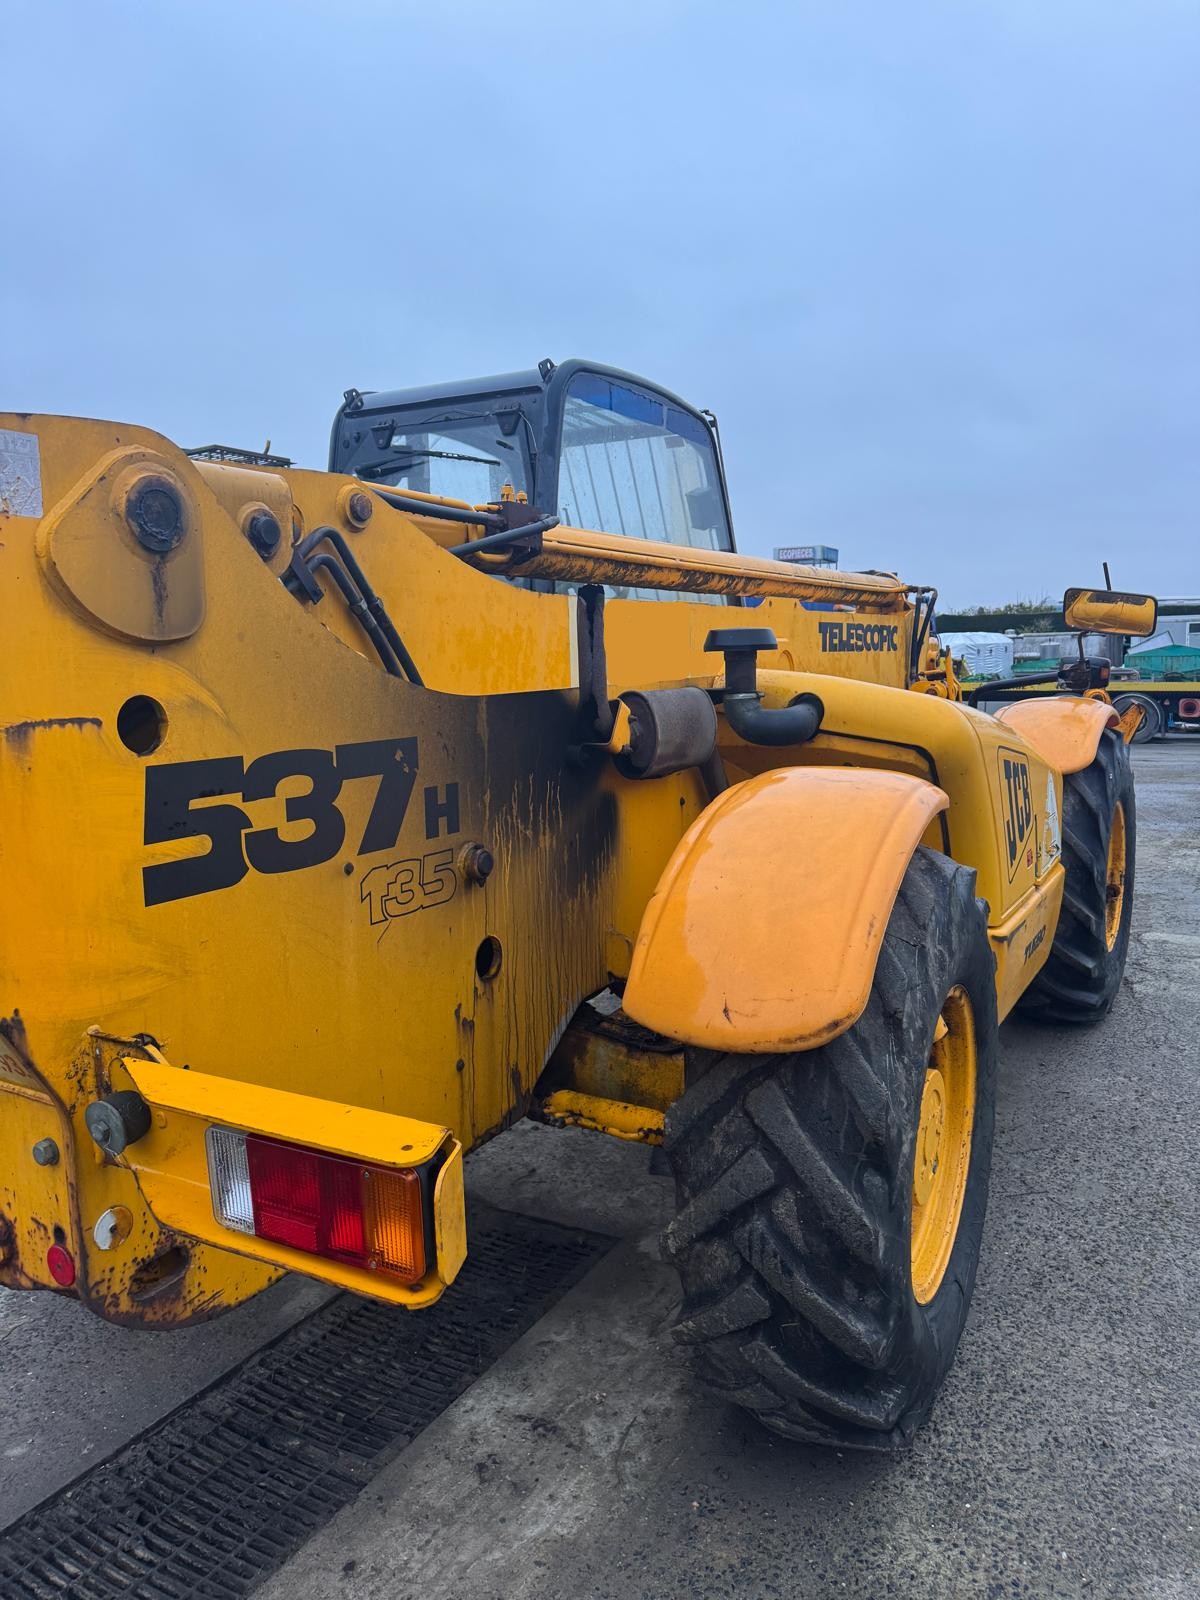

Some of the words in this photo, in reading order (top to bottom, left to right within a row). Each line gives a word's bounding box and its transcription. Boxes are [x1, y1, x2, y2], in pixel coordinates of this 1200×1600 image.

[818, 622, 898, 653] TELESCOPIC
[142, 736, 419, 907] 537
[424, 782, 460, 840] H
[1003, 759, 1033, 868] JCB
[360, 848, 458, 925] 135
